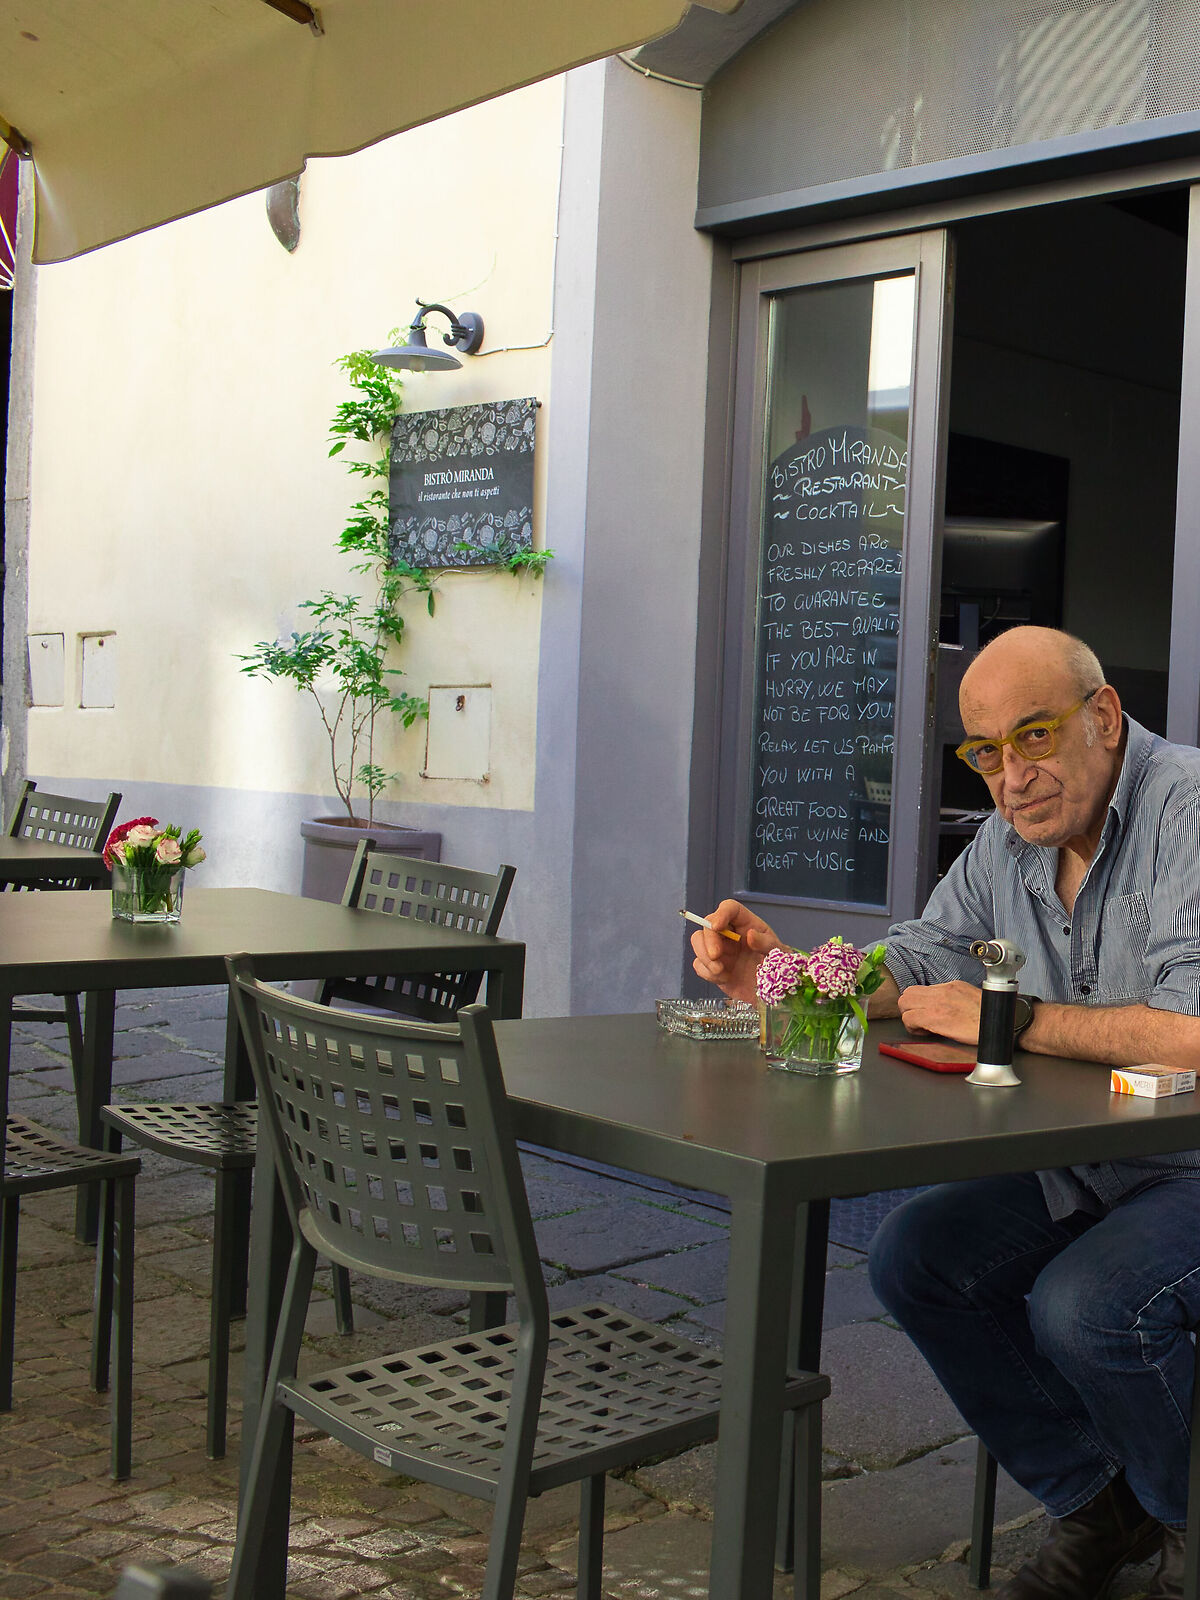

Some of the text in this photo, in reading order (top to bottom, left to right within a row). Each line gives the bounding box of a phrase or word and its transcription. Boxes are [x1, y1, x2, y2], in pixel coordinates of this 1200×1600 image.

[424, 467, 494, 486] BISTRÒ MIRANDA
[771, 446, 826, 489] BISTRO
[423, 490, 451, 502] ristorante
[451, 487, 461, 500] che
[462, 489, 473, 498] non
[793, 471, 899, 498] RESTAURANT
[795, 501, 888, 521] COCKTAIL
[767, 533, 889, 562] OUR DISHES ARE
[767, 564, 827, 584] FRESHLY
[764, 589, 886, 612] TO GUARANTEE
[763, 622, 793, 640] THE
[800, 620, 849, 640] BEST
[766, 645, 878, 672] IF YOU ARE IN
[818, 681, 844, 698] WE
[852, 676, 889, 694] MAY
[763, 706, 785, 722] NOT
[789, 705, 811, 723] BE
[816, 704, 850, 723] FOR
[804, 739, 830, 753] LET
[833, 738, 854, 755] US
[759, 764, 855, 787] YOU WITH A
[756, 796, 805, 818] GREAT
[755, 822, 889, 845] GREAT WINE AND
[755, 850, 855, 872] GREAT MUSIC
